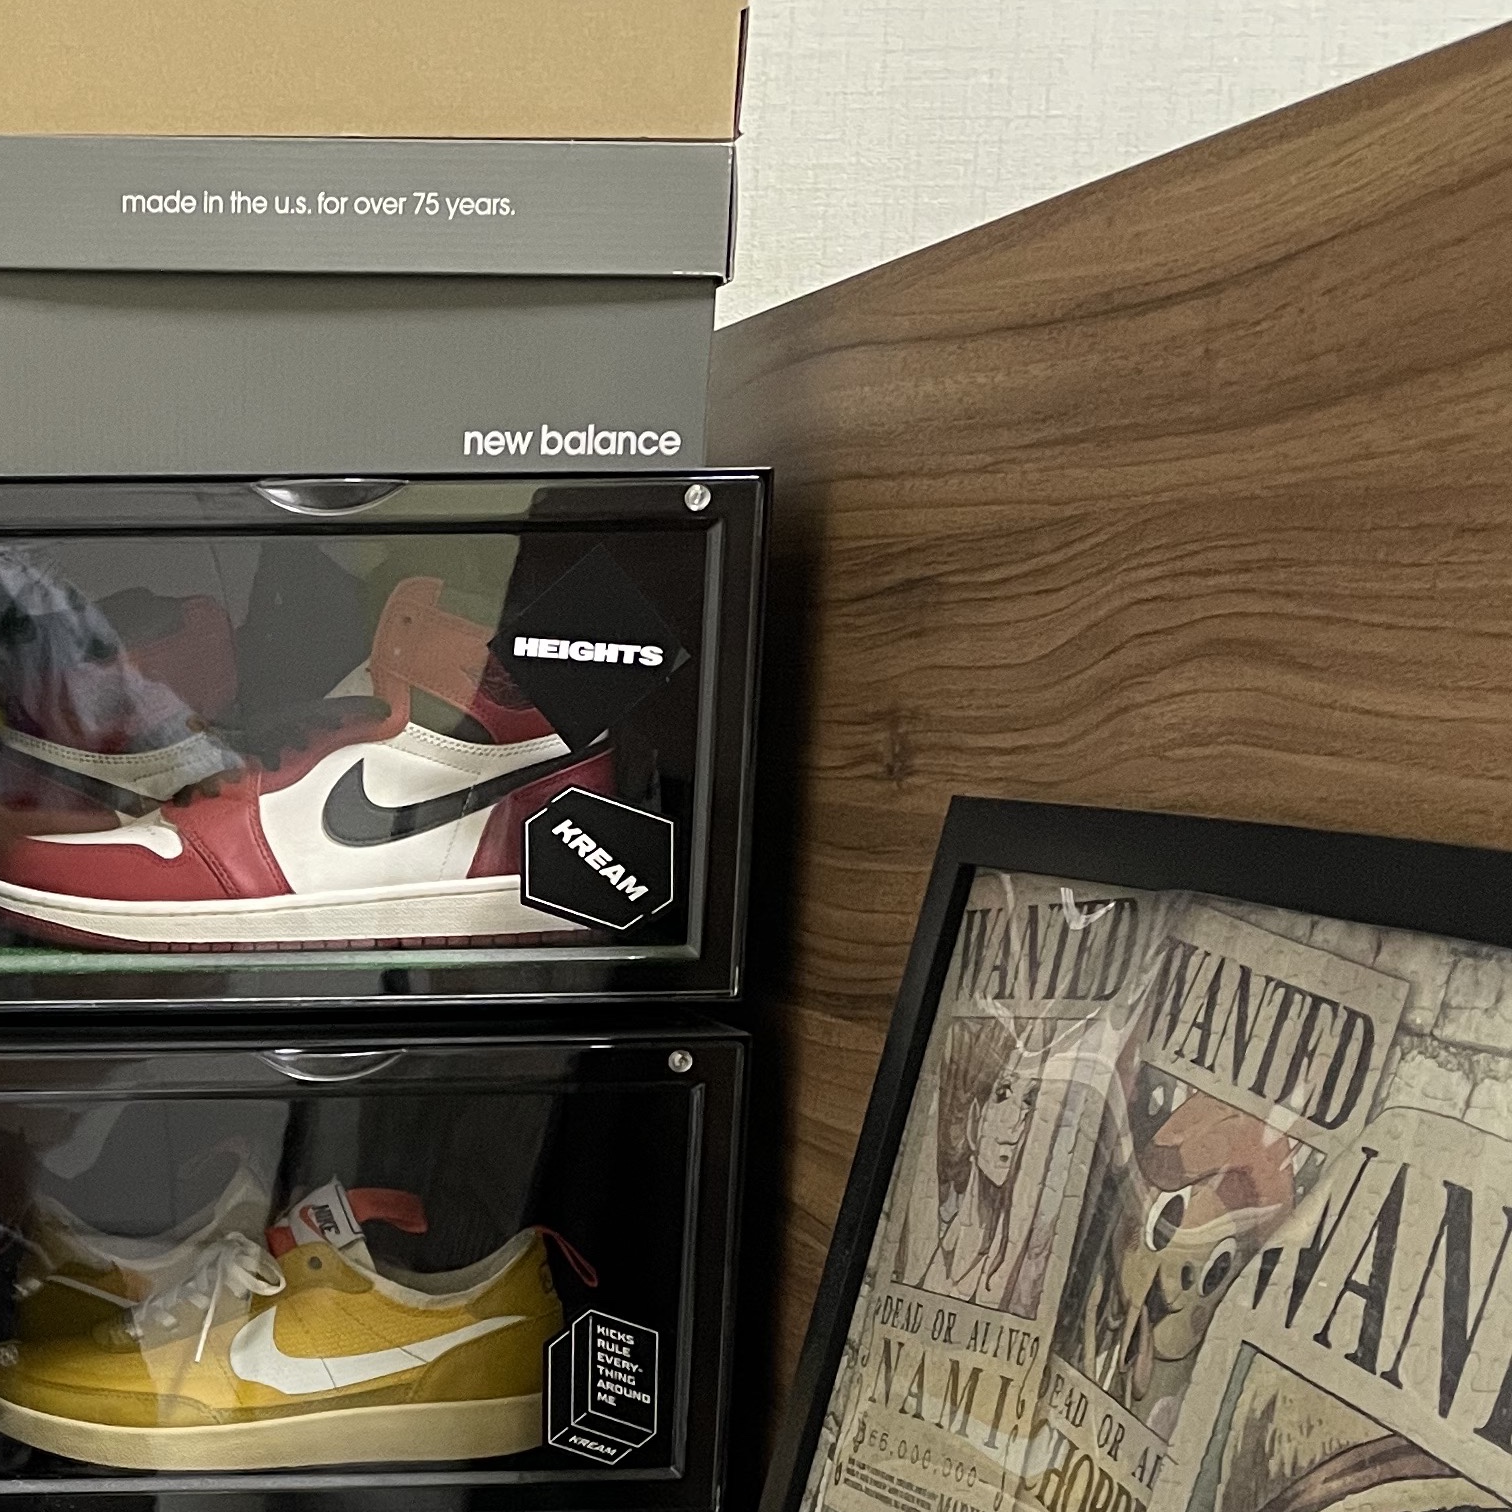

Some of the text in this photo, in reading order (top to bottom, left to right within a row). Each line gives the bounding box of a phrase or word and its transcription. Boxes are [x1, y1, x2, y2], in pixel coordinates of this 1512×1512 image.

[121, 191, 517, 220] made in the u.s. for over 75 years.
[463, 423, 682, 456] new balance
[513, 636, 664, 667] HEIGHTS
[552, 819, 649, 902] KREAM
[1147, 936, 1375, 1131] WANTED
[597, 1324, 635, 1345] KICKS
[881, 1295, 1031, 1366] DEAD OR ALIVE
[597, 1338, 631, 1358] RULE
[597, 1352, 643, 1373] EVERY-
[597, 1365, 636, 1386] THING
[597, 1379, 651, 1404] AROUND
[597, 1392, 617, 1407] ME
[868, 1337, 1014, 1450] NAMI
[569, 1435, 617, 1456] KREAM
[1098, 1414, 1125, 1462] OR
